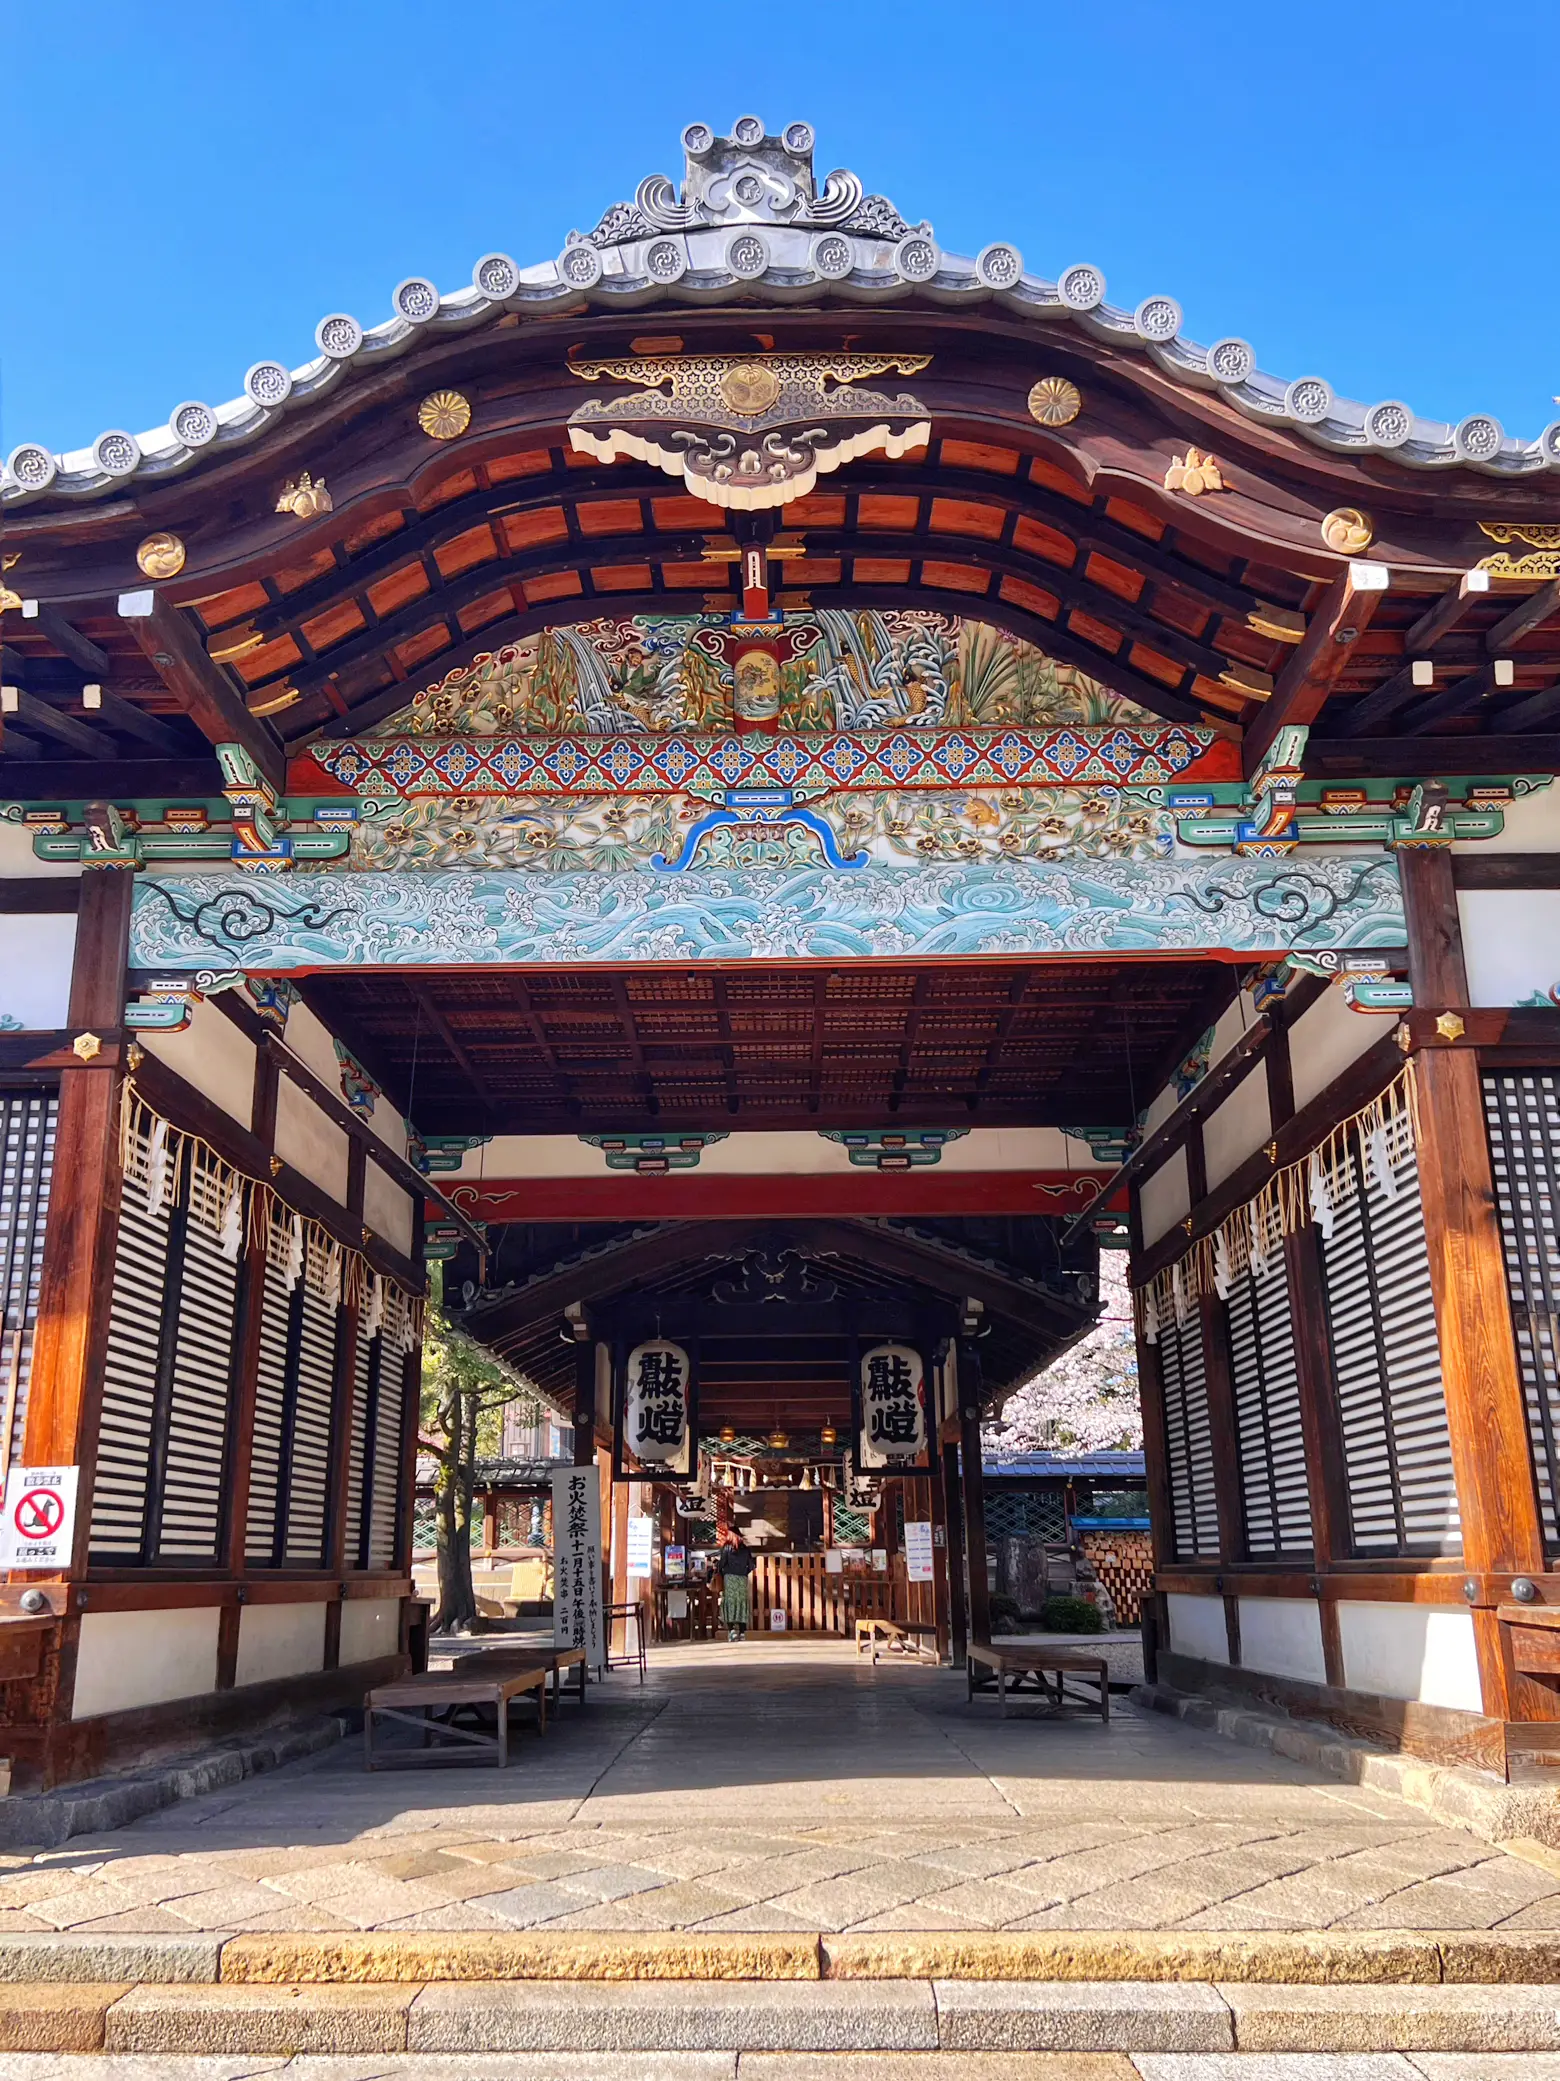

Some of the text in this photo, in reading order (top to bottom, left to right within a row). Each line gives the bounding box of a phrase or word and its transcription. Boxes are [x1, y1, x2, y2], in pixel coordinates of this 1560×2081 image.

[566, 1475, 588, 1648] お火焚祭十一月十五日午後時焼
